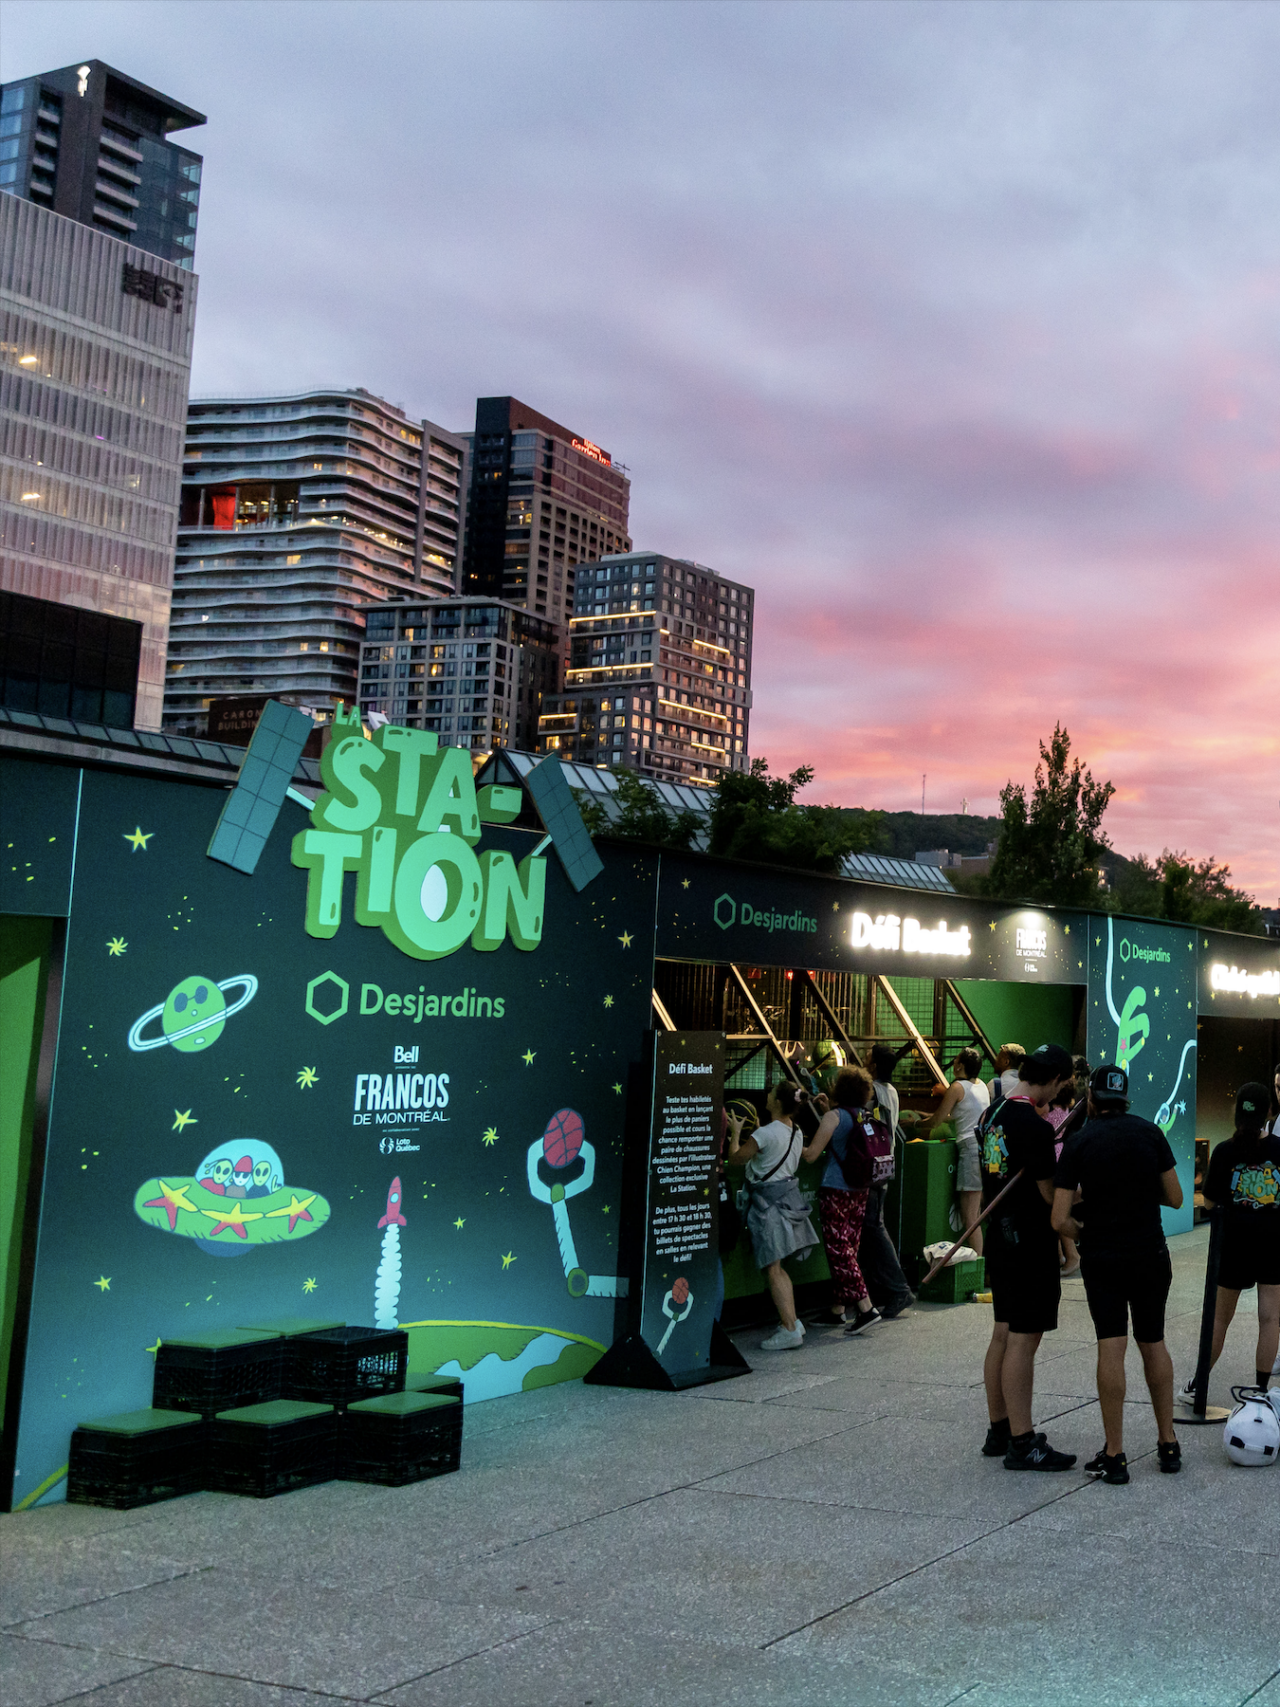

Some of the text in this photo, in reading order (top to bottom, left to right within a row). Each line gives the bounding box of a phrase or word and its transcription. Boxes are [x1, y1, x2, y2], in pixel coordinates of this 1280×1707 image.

[571, 438, 598, 460] Garden
[223, 709, 262, 720] CARON
[335, 702, 361, 727] LA
[218, 720, 257, 731] BUILDIN
[296, 826, 548, 956] TION
[741, 902, 817, 933] Desjardins
[1132, 943, 1171, 963] Desjardins
[360, 983, 505, 1023] Desjardins
[394, 1046, 419, 1063] Bell
[669, 1063, 713, 1074] Défi Basket
[354, 1073, 450, 1111] FRANCOS
[353, 1109, 447, 1125] DE MONTRÉAL
[657, 1166, 673, 1174] Chien
